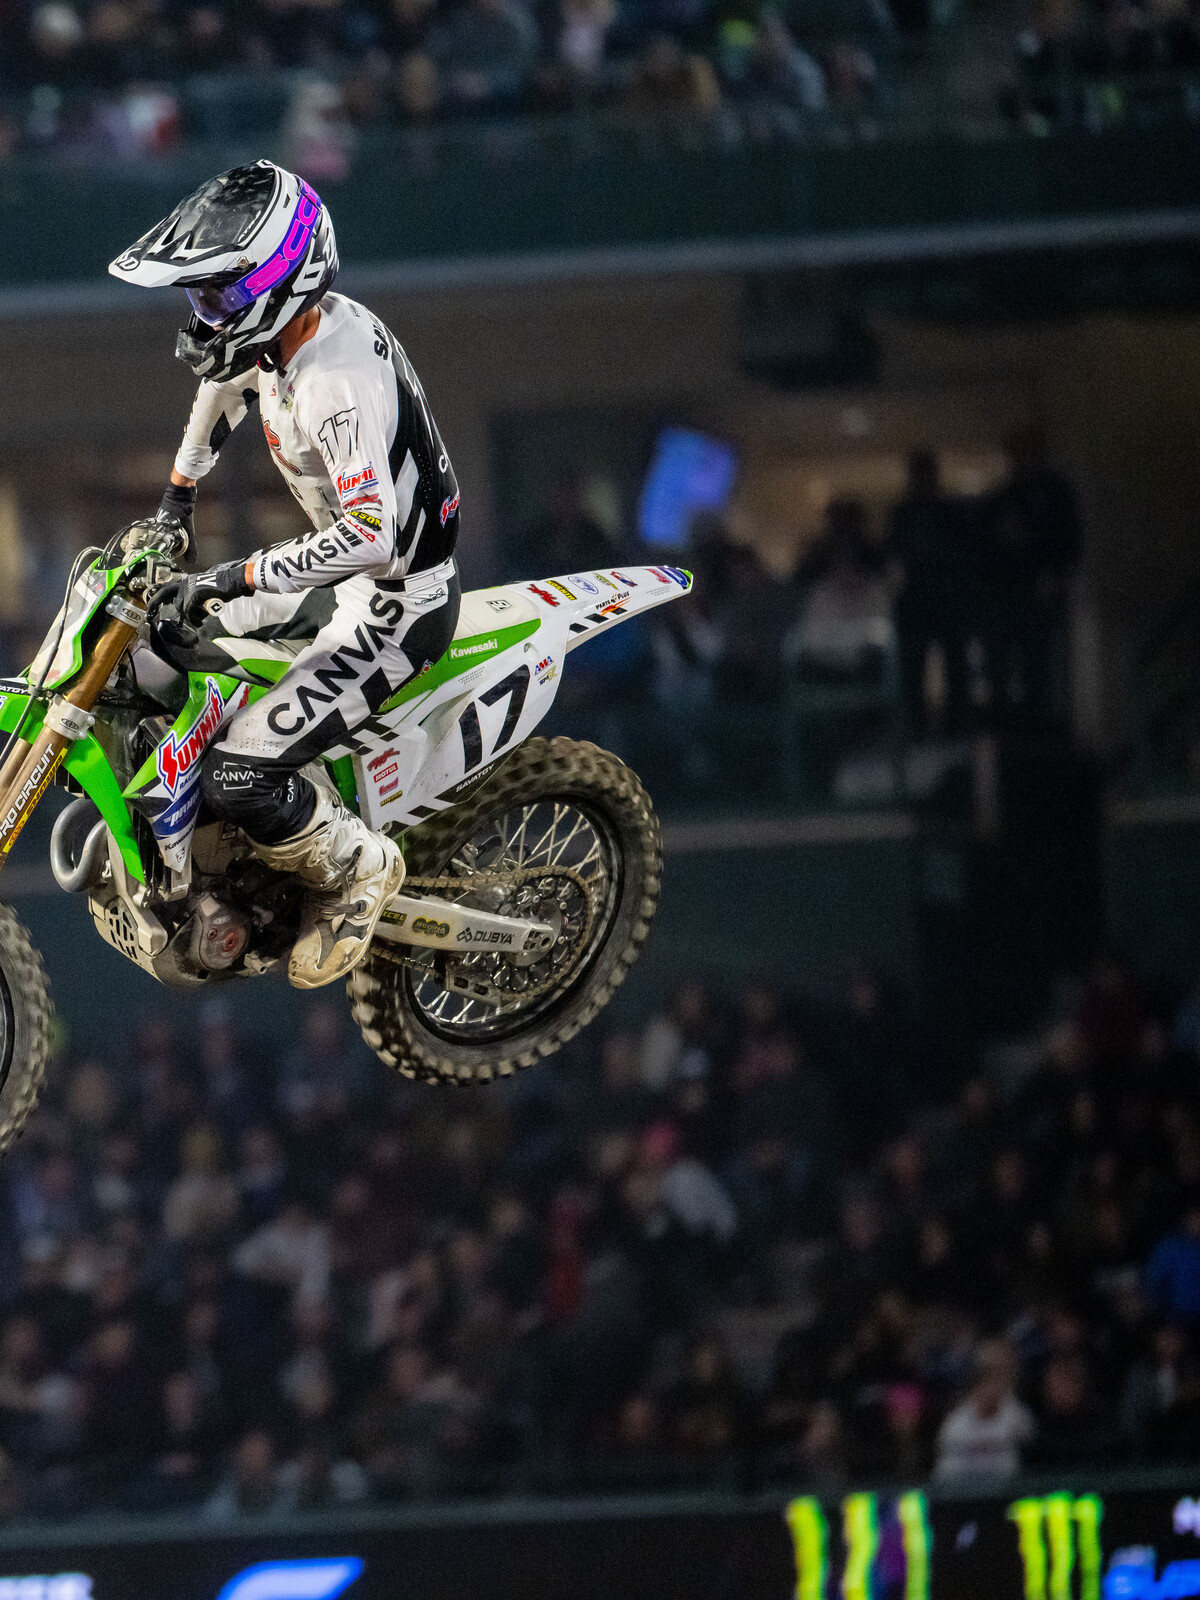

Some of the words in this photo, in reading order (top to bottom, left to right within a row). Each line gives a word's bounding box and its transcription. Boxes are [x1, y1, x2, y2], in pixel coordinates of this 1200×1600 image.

[317, 406, 357, 465] 17
[595, 598, 611, 611] PARTS
[617, 590, 630, 601] PLUS
[450, 638, 498, 659] Kawasaki
[267, 592, 404, 736] CANVAS
[458, 664, 530, 775] 17
[14, 742, 55, 812] CIRCUIT
[213, 769, 264, 782] CANVAS
[375, 764, 397, 782] MOTUL
[381, 909, 406, 922] XCEL
[473, 930, 513, 945] DUBYA
